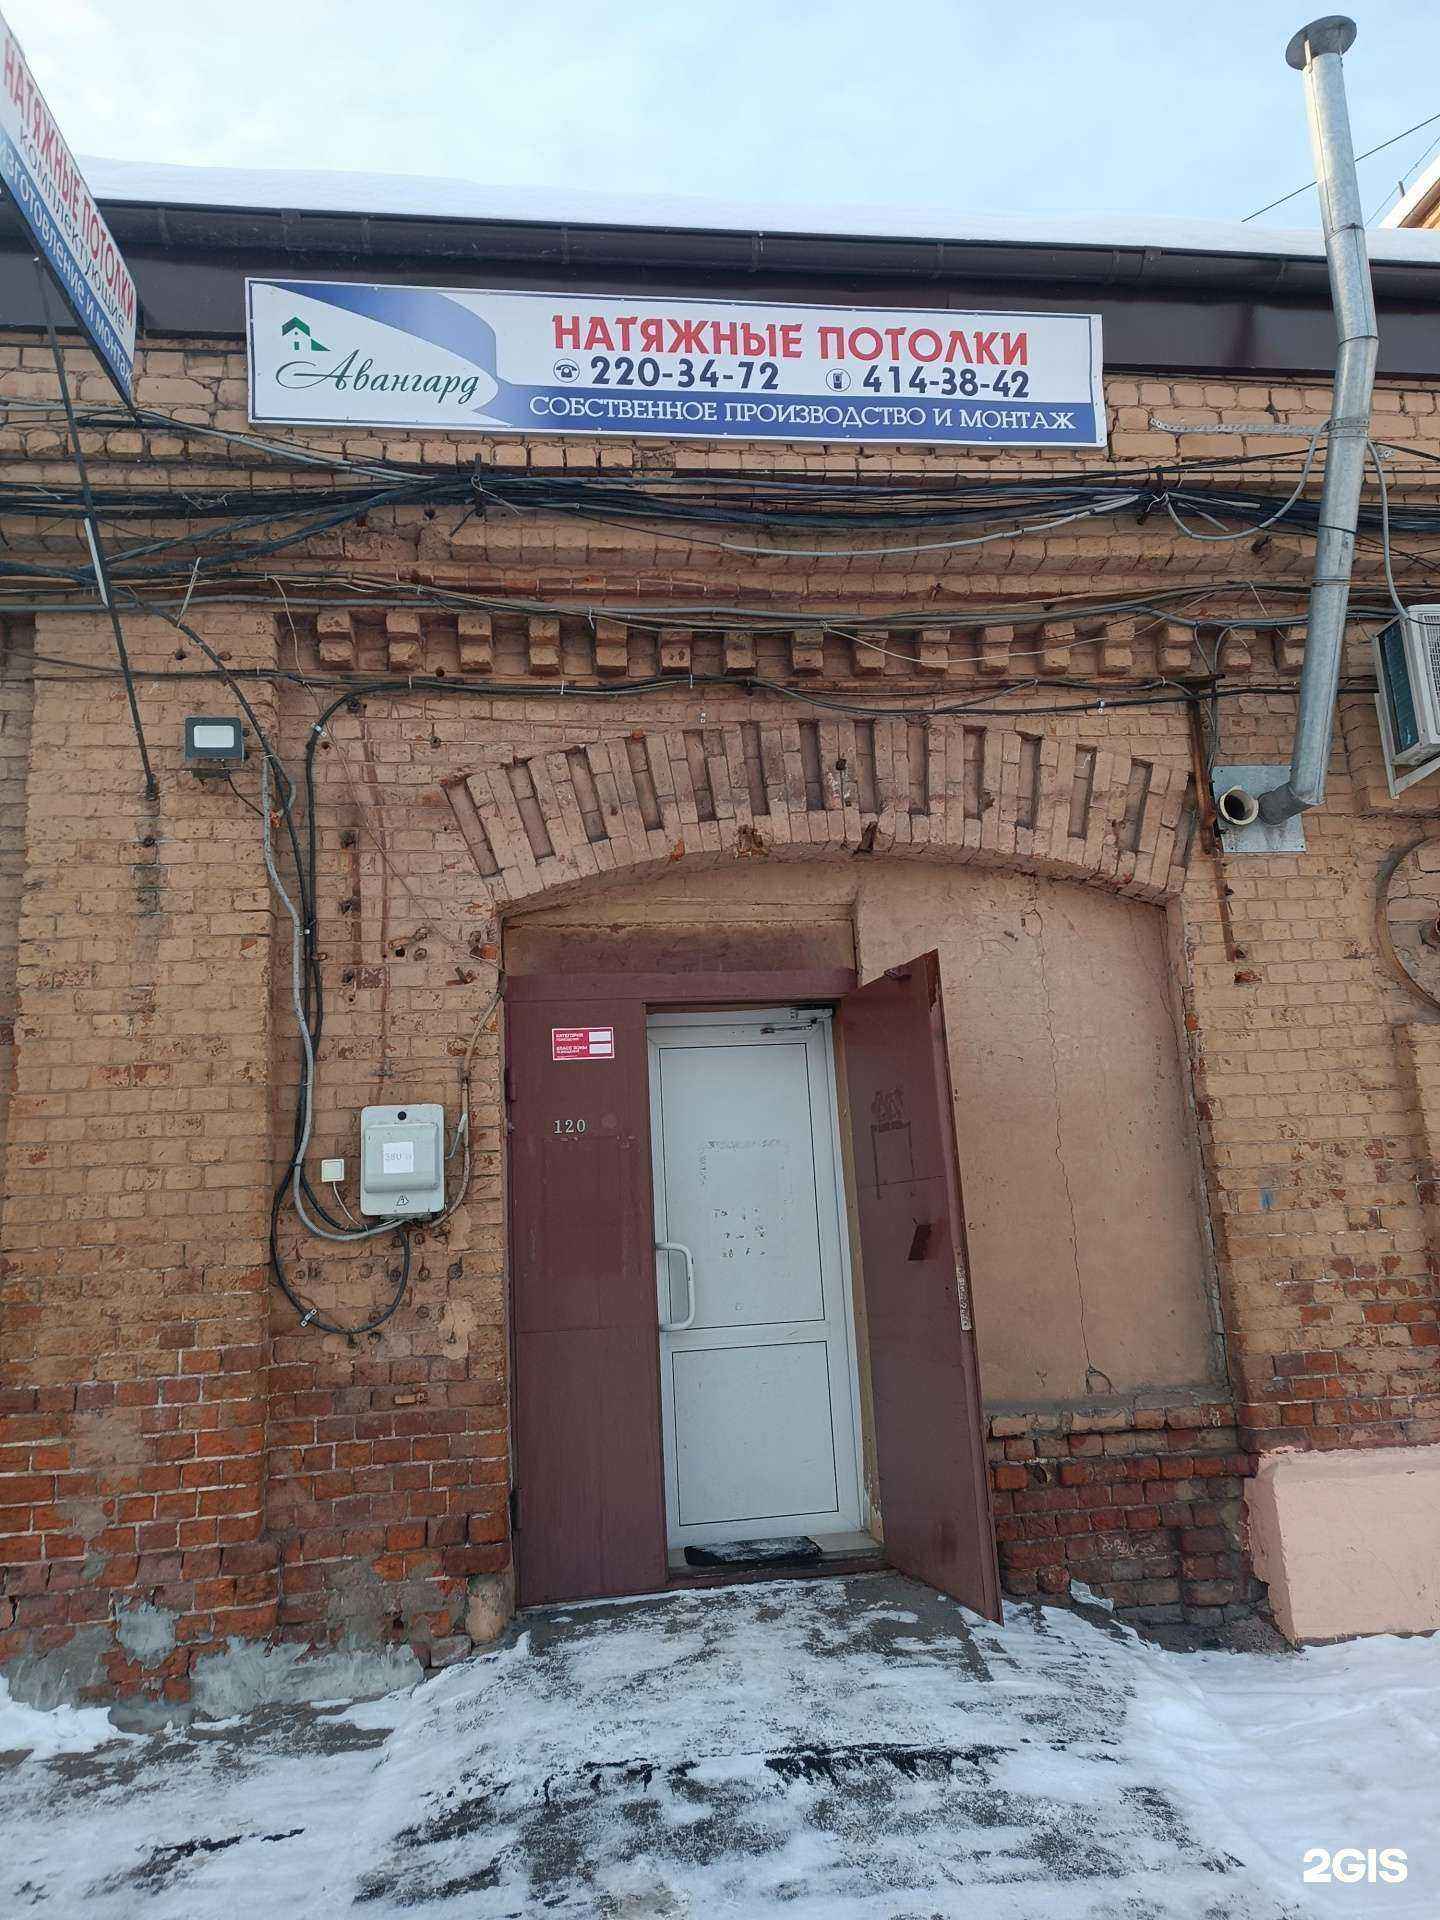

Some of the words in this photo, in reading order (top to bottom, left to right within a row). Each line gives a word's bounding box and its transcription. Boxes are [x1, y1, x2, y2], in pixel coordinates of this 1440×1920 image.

[3, 36, 81, 223] НАТЯЖНЫЕ
[82, 195, 135, 328] ПОТОЛКИ
[552, 314, 803, 359] НАТЯЖНЫЕ
[817, 326, 1028, 366] ПОТОЛКИ
[275, 349, 480, 405] Авангард
[590, 355, 779, 390] 220-34-72
[862, 365, 1029, 398] 414-38-42
[529, 396, 718, 421] СОБСТВЕННОЕ
[724, 402, 926, 428] ПРОИЗВОДСТВО
[932, 408, 953, 428] И
[959, 409, 1076, 430] МОНТАЖ
[553, 1119, 586, 1133] 120
